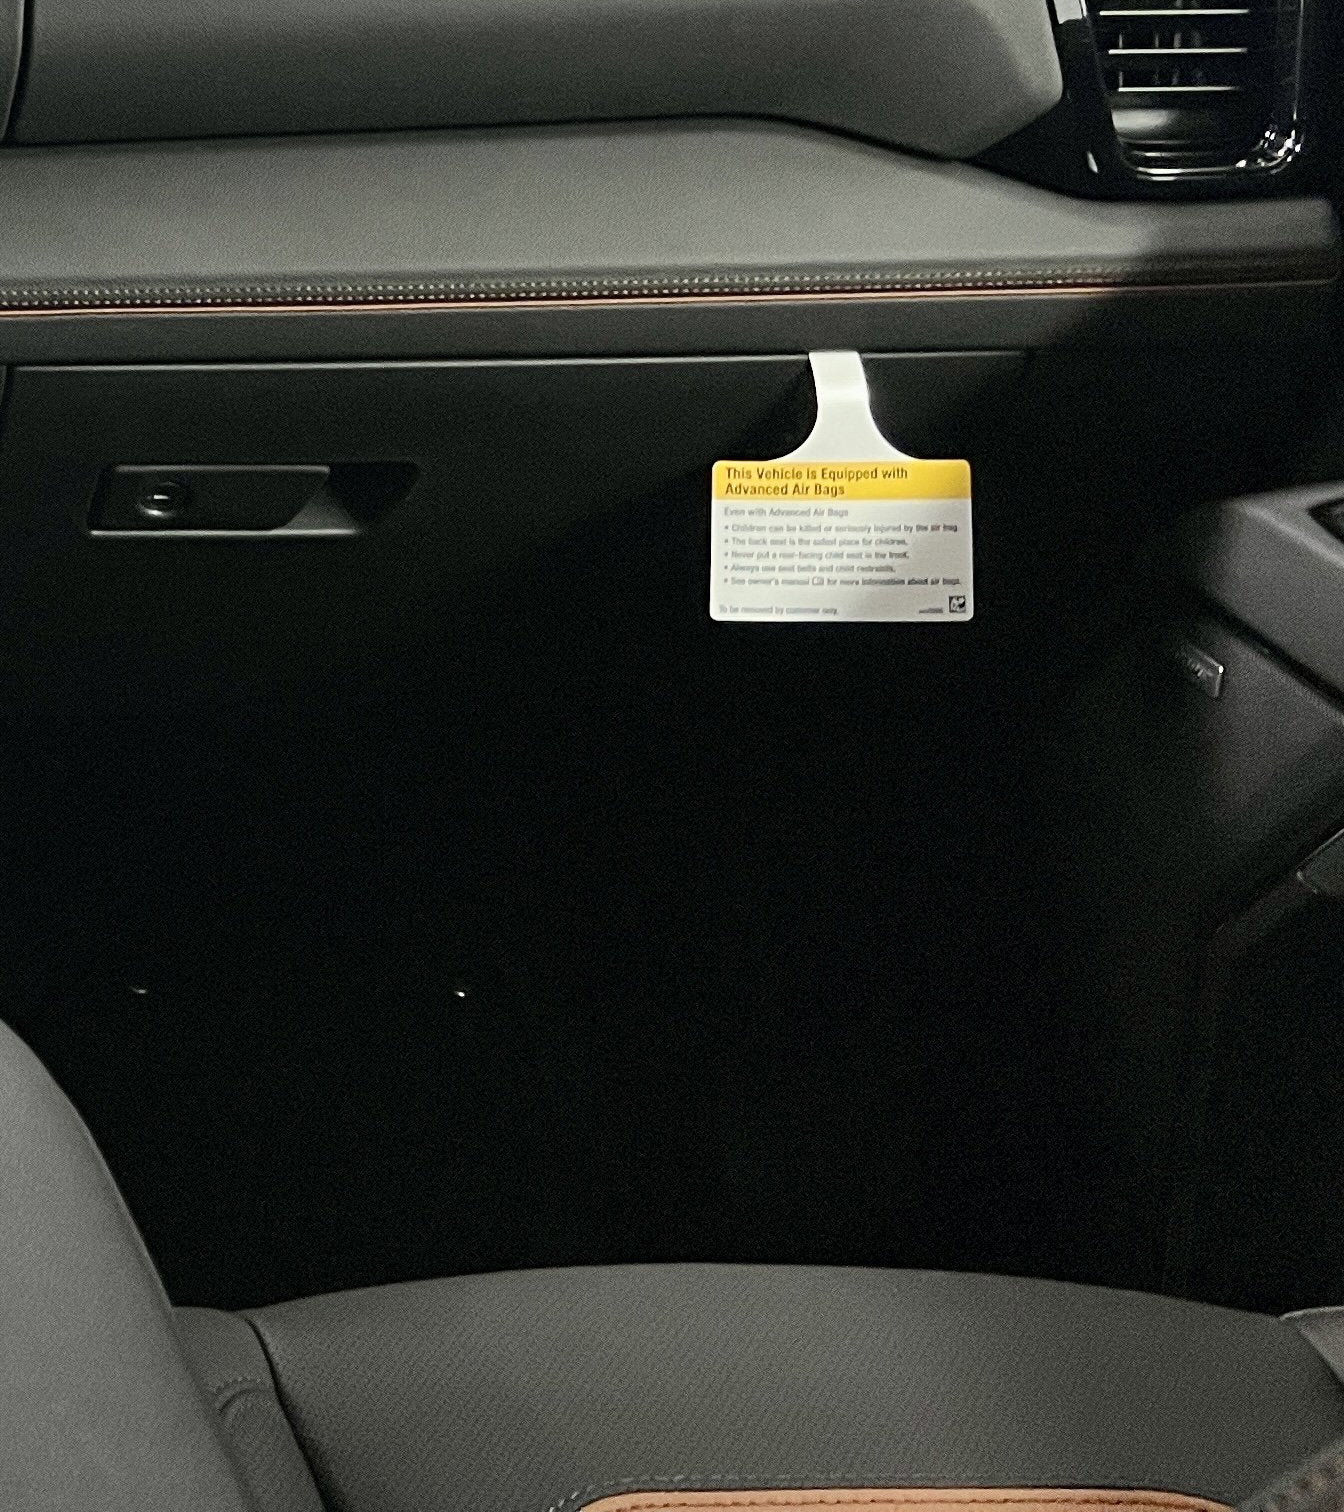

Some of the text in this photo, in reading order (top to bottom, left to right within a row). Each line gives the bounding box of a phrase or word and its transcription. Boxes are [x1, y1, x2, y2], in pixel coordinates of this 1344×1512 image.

[725, 467, 752, 480] This
[755, 467, 803, 480] Vehicle
[821, 467, 878, 482] Equipped
[881, 467, 909, 479] with
[725, 483, 845, 497] Advanced Air Bags
[724, 508, 745, 517] Even
[748, 508, 766, 516] with
[769, 508, 811, 516] Advanced
[813, 508, 825, 516] Air
